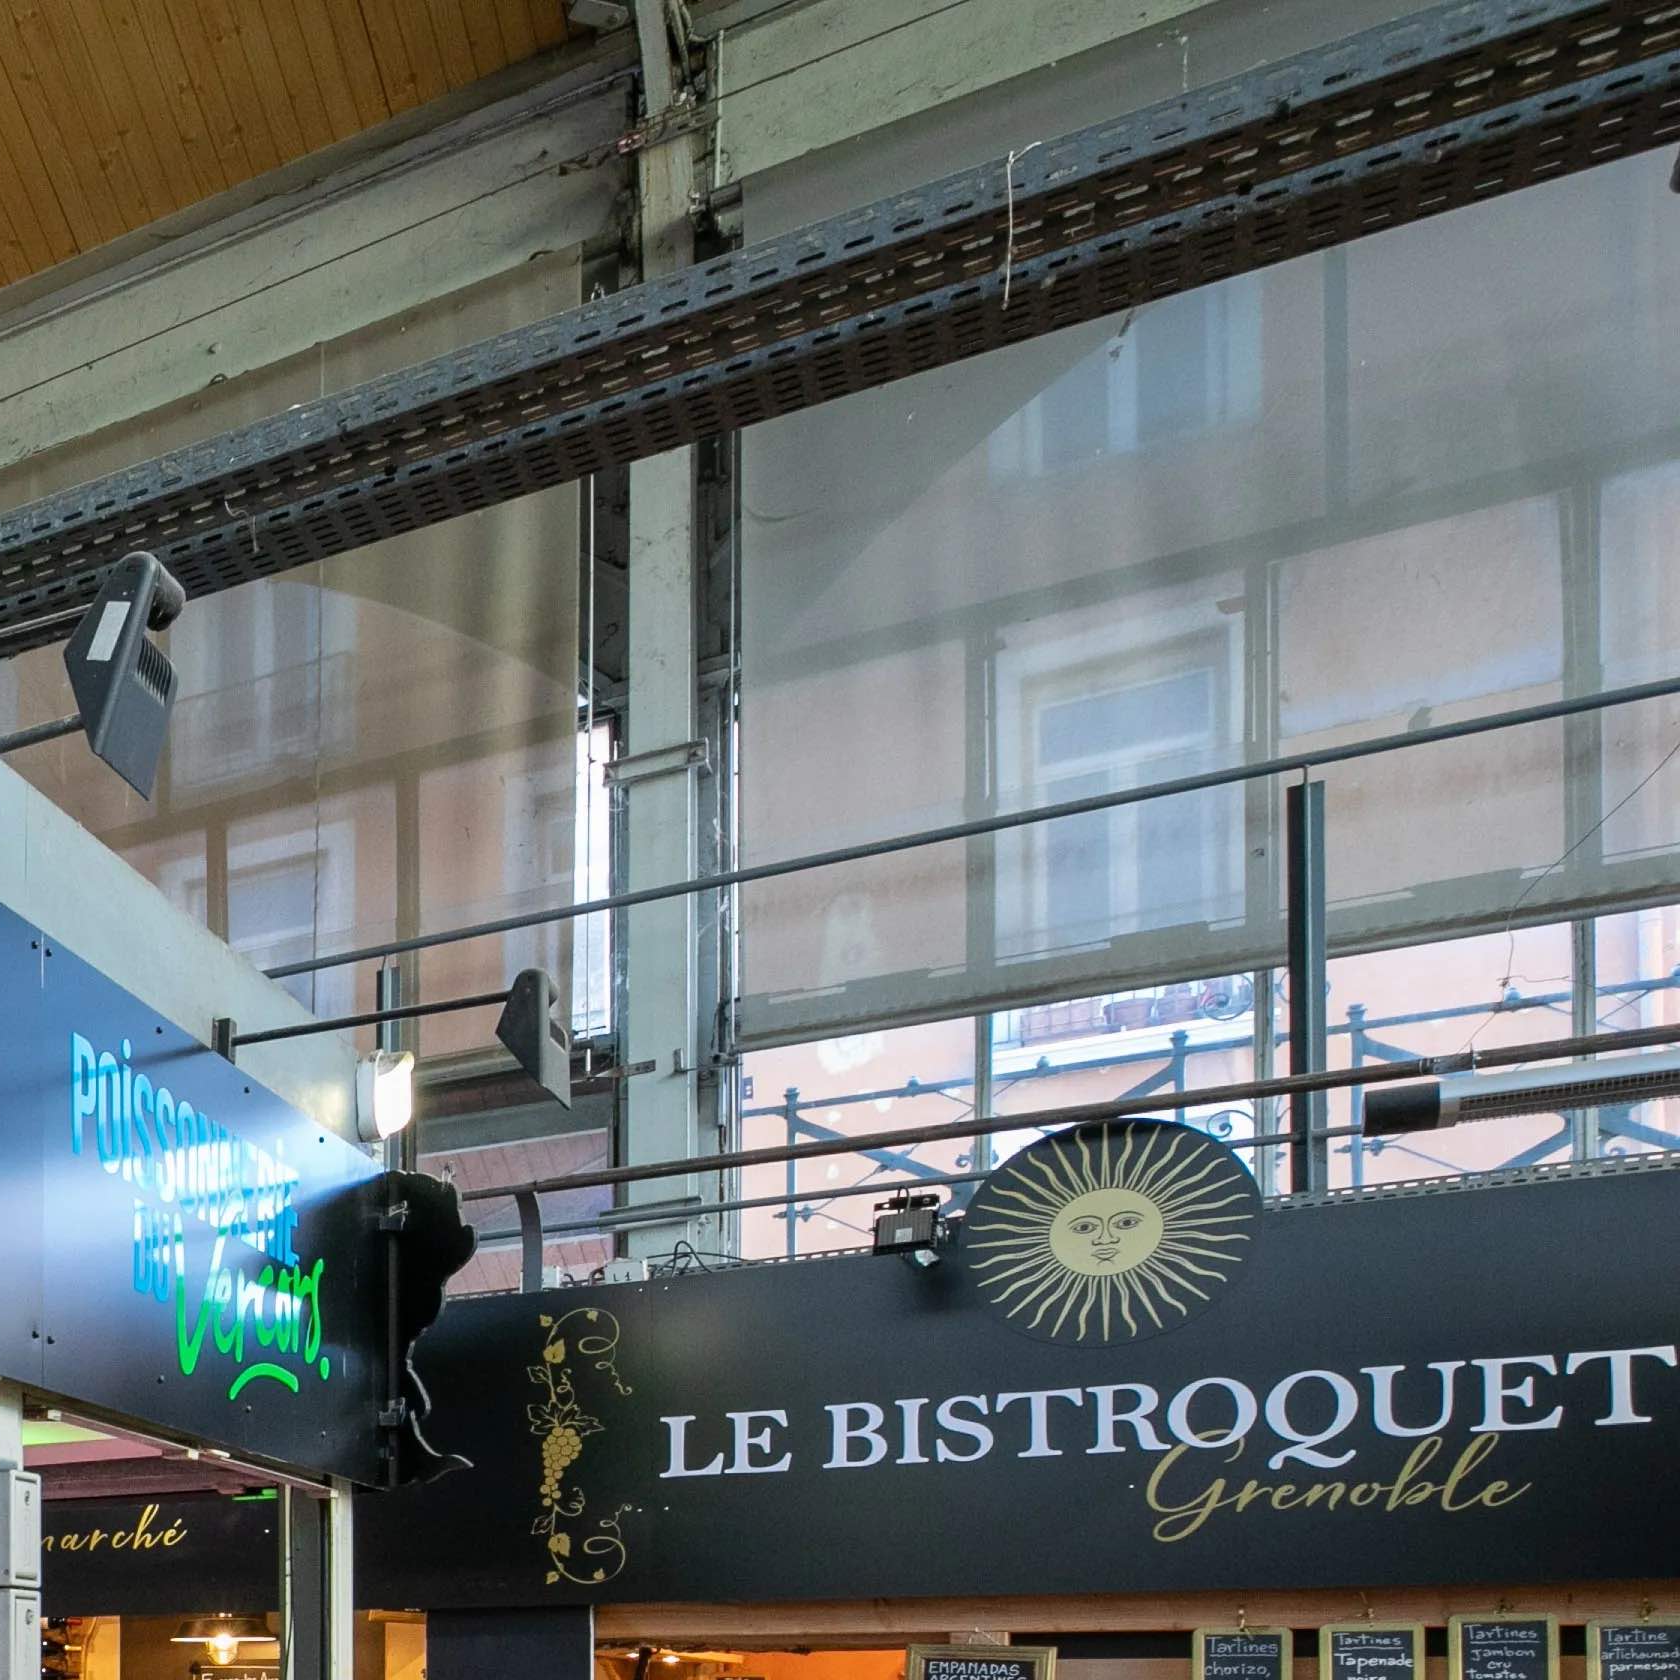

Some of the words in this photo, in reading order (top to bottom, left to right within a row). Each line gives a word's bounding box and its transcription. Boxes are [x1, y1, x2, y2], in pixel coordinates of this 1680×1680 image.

[134, 1199, 170, 1303] DU
[659, 1410, 793, 1478] LE
[823, 1345, 1678, 1472] BISTROQUET
[1146, 1430, 1531, 1543] Grenoble
[1333, 1632, 1401, 1646] Tartines
[1465, 1624, 1538, 1640] Tartines
[1603, 1629, 1669, 1642] Tartine
[1207, 1636, 1278, 1654] Tartines
[928, 1662, 1020, 1676] EMPANADAS
[1204, 1662, 1271, 1678] chorizo,
[1333, 1652, 1414, 1674] Tapenade
